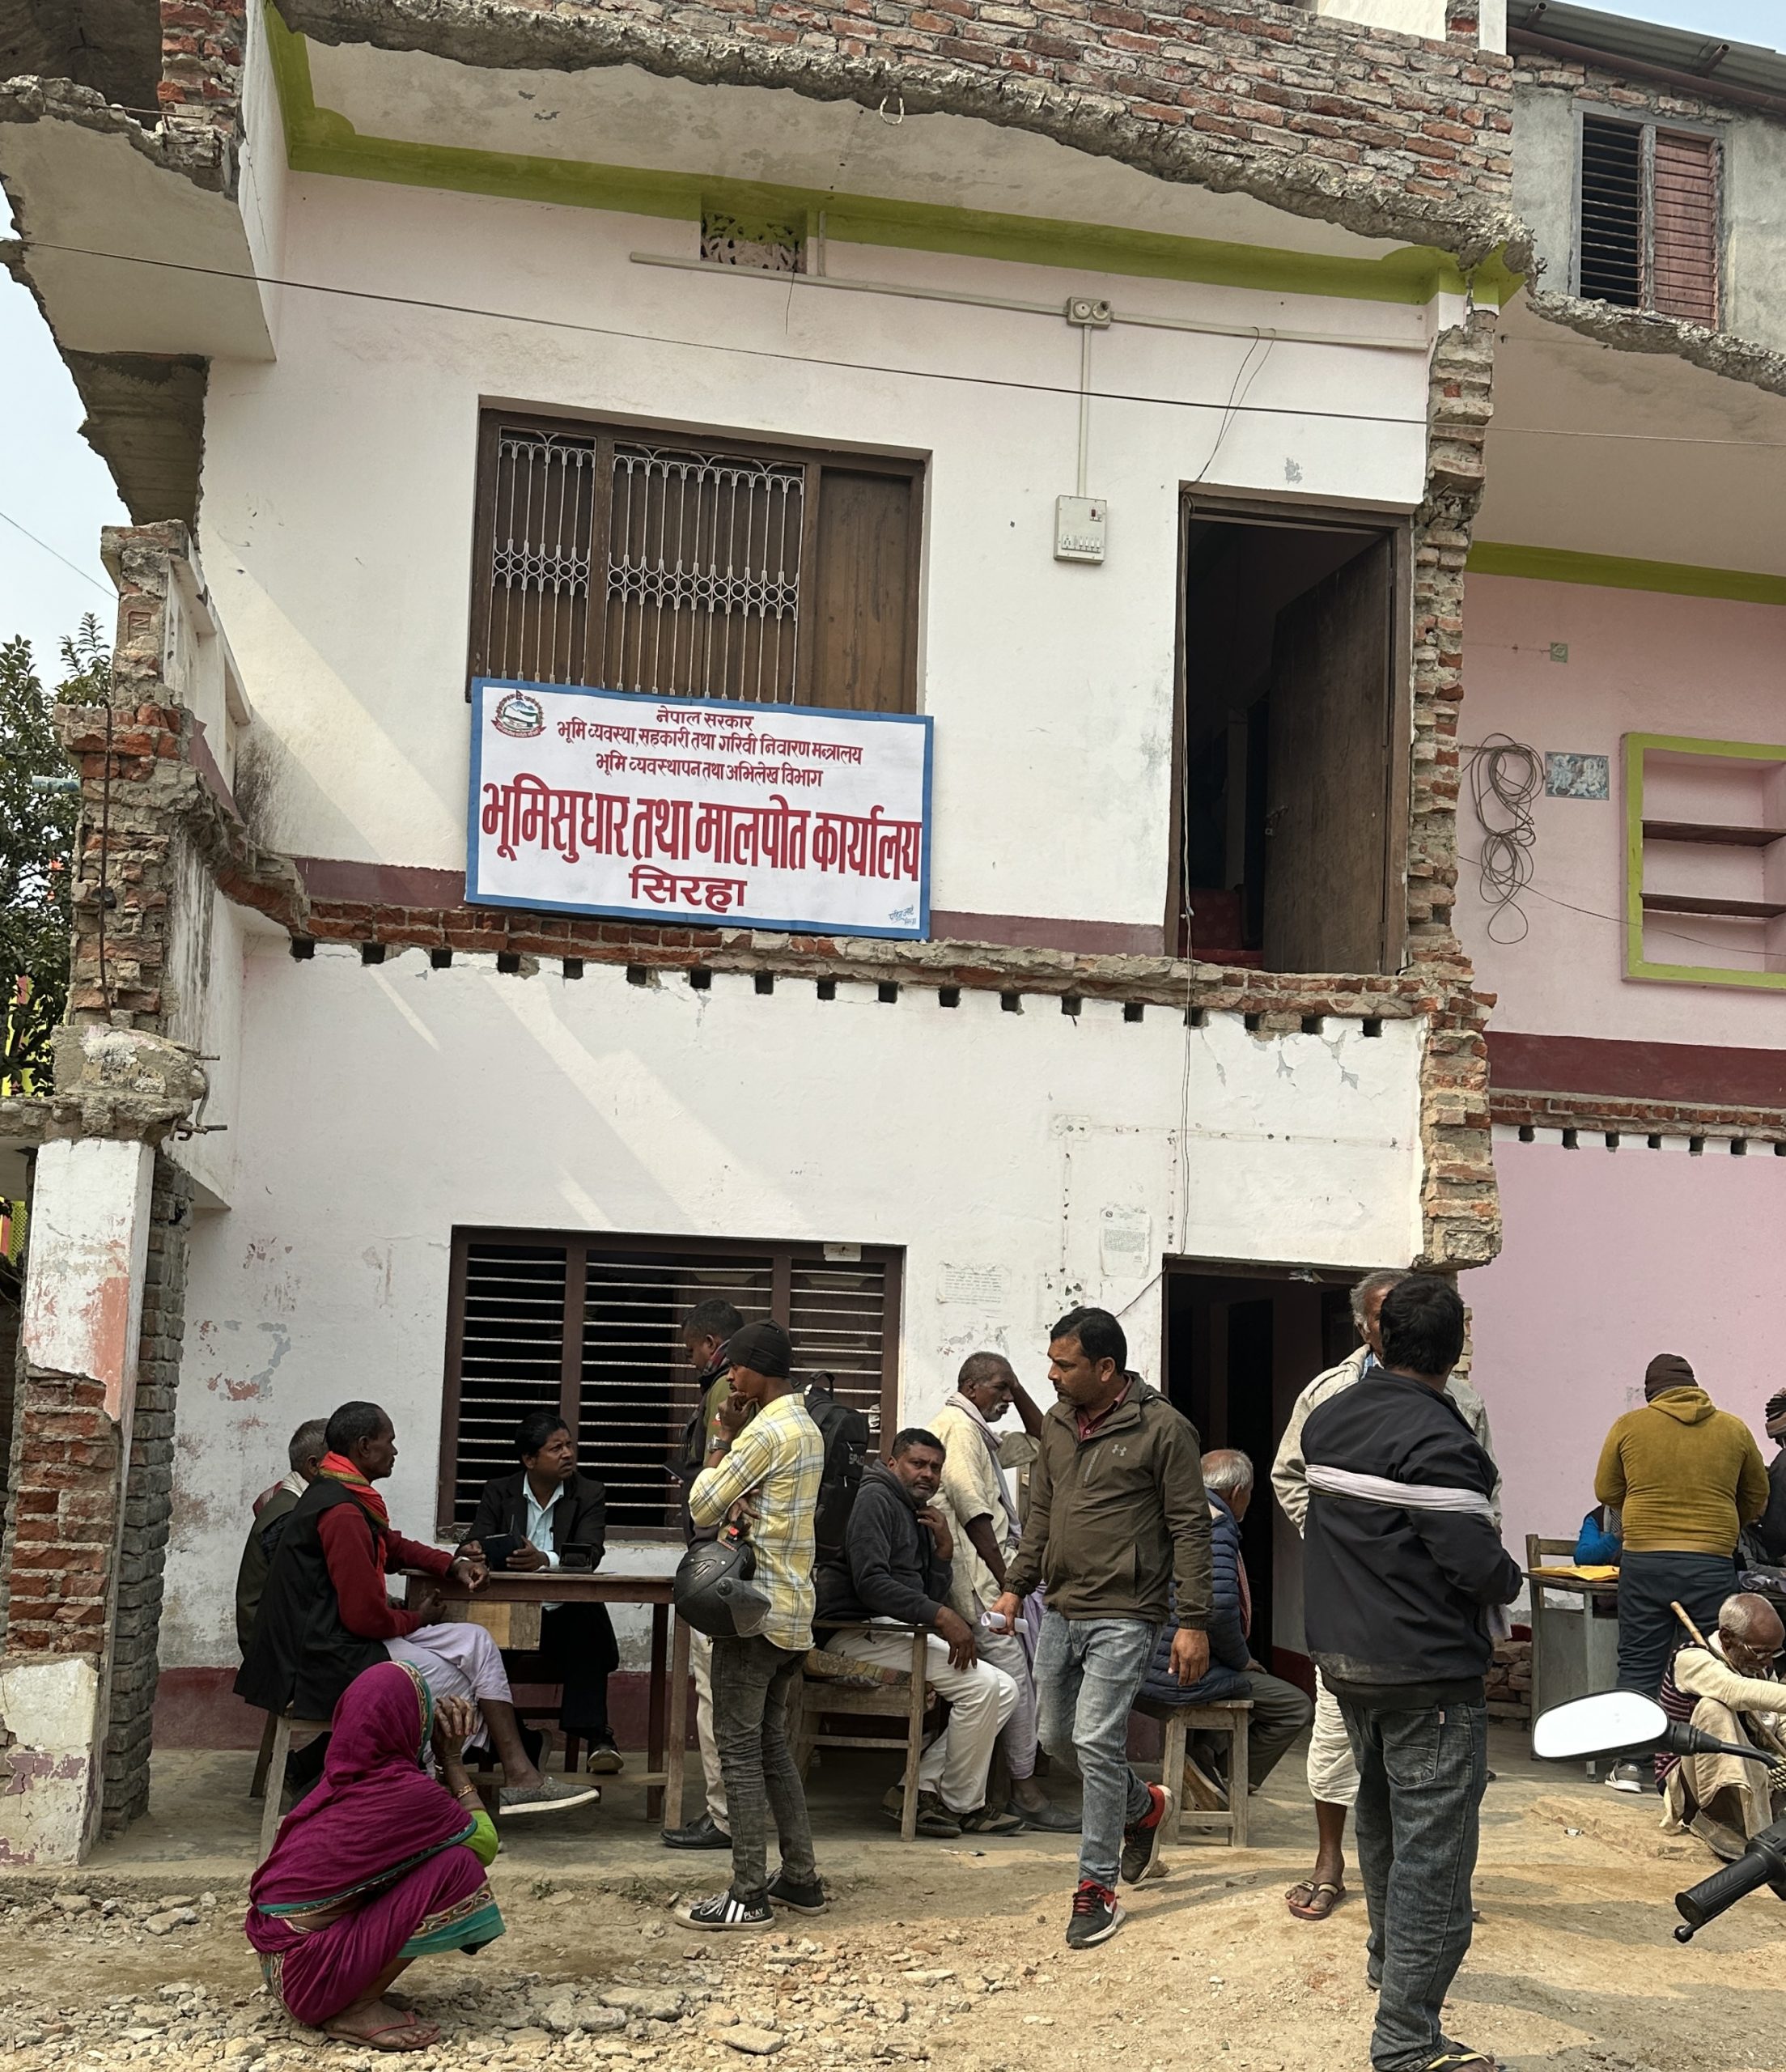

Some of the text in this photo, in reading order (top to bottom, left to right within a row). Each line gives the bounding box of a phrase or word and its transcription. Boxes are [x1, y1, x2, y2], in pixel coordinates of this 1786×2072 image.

[557, 716, 587, 744] भूमि
[638, 727, 690, 749] सहकारी
[691, 732, 717, 750] तथा
[760, 733, 811, 758] निवारण
[656, 705, 754, 731] नेपाल सरकार
[596, 749, 823, 787] भूमि व्यवस्थापन तथा अभिलेख विभाग
[633, 798, 694, 860] तथा
[695, 794, 812, 871] मालपोत
[812, 805, 923, 882] कार्यालय
[629, 864, 748, 913] सिरहा
